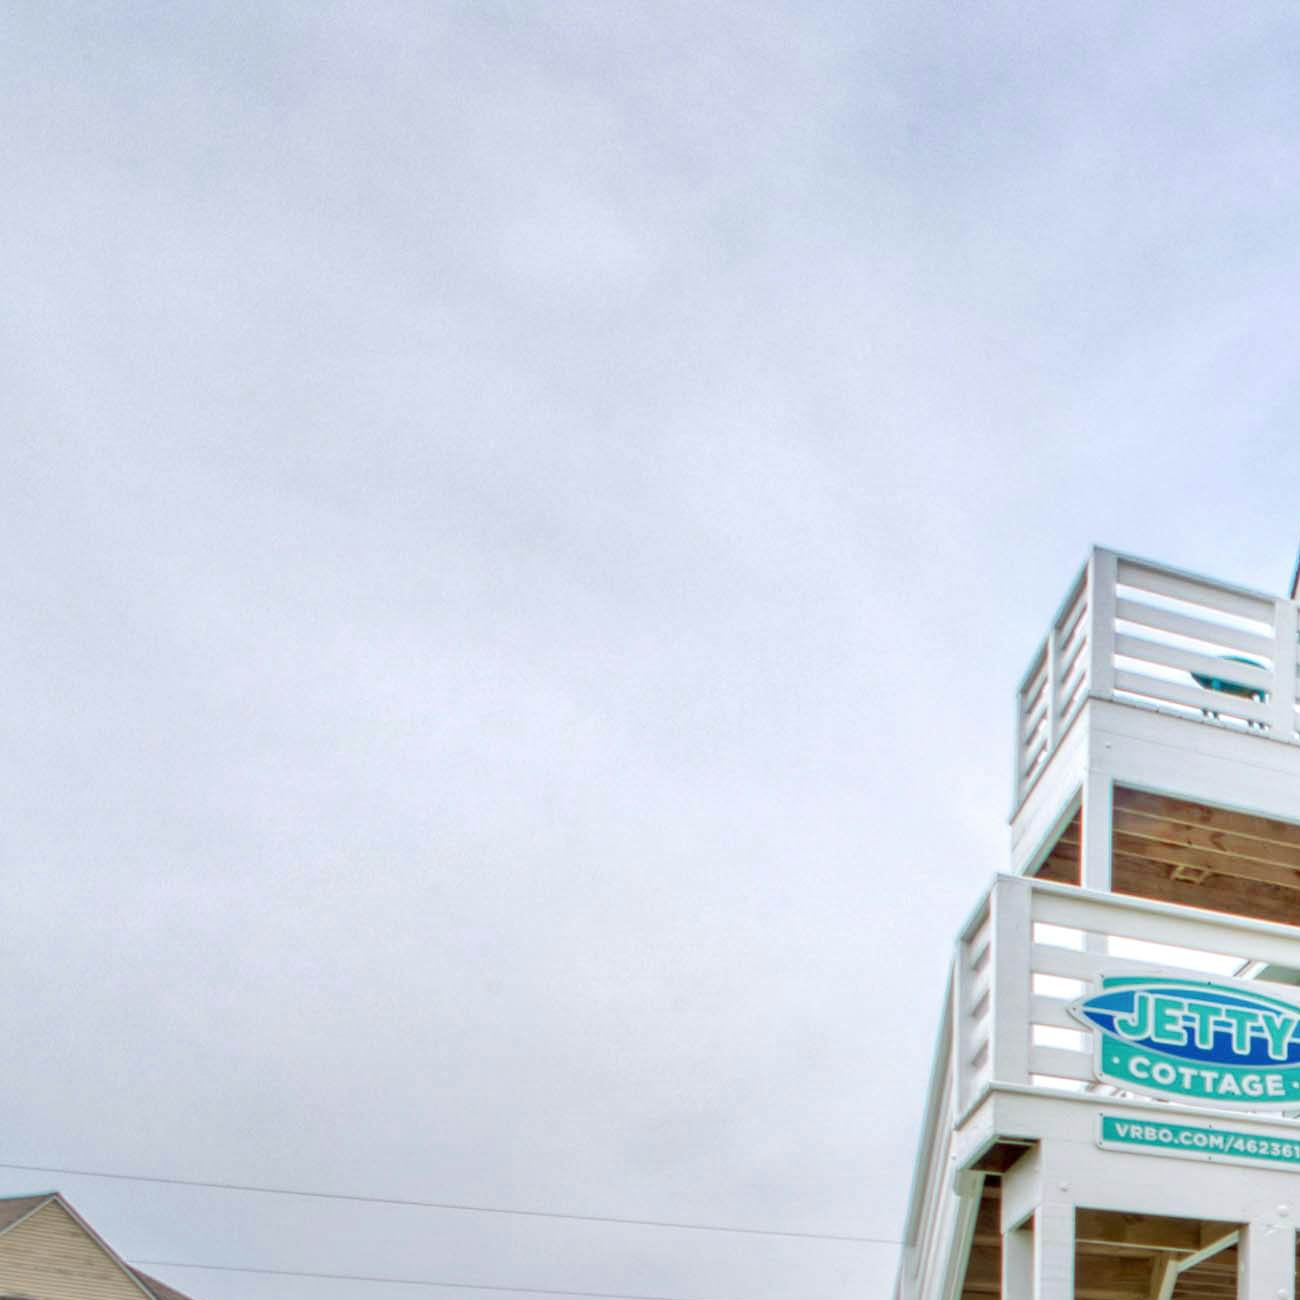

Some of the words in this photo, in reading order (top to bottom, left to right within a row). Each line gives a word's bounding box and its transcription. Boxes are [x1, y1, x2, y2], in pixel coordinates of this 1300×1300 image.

[1113, 991, 1295, 1060] JETTY
[1129, 1056, 1286, 1096] COTTAGE
[1115, 1123, 1300, 1158] VRBO.COM/462361
